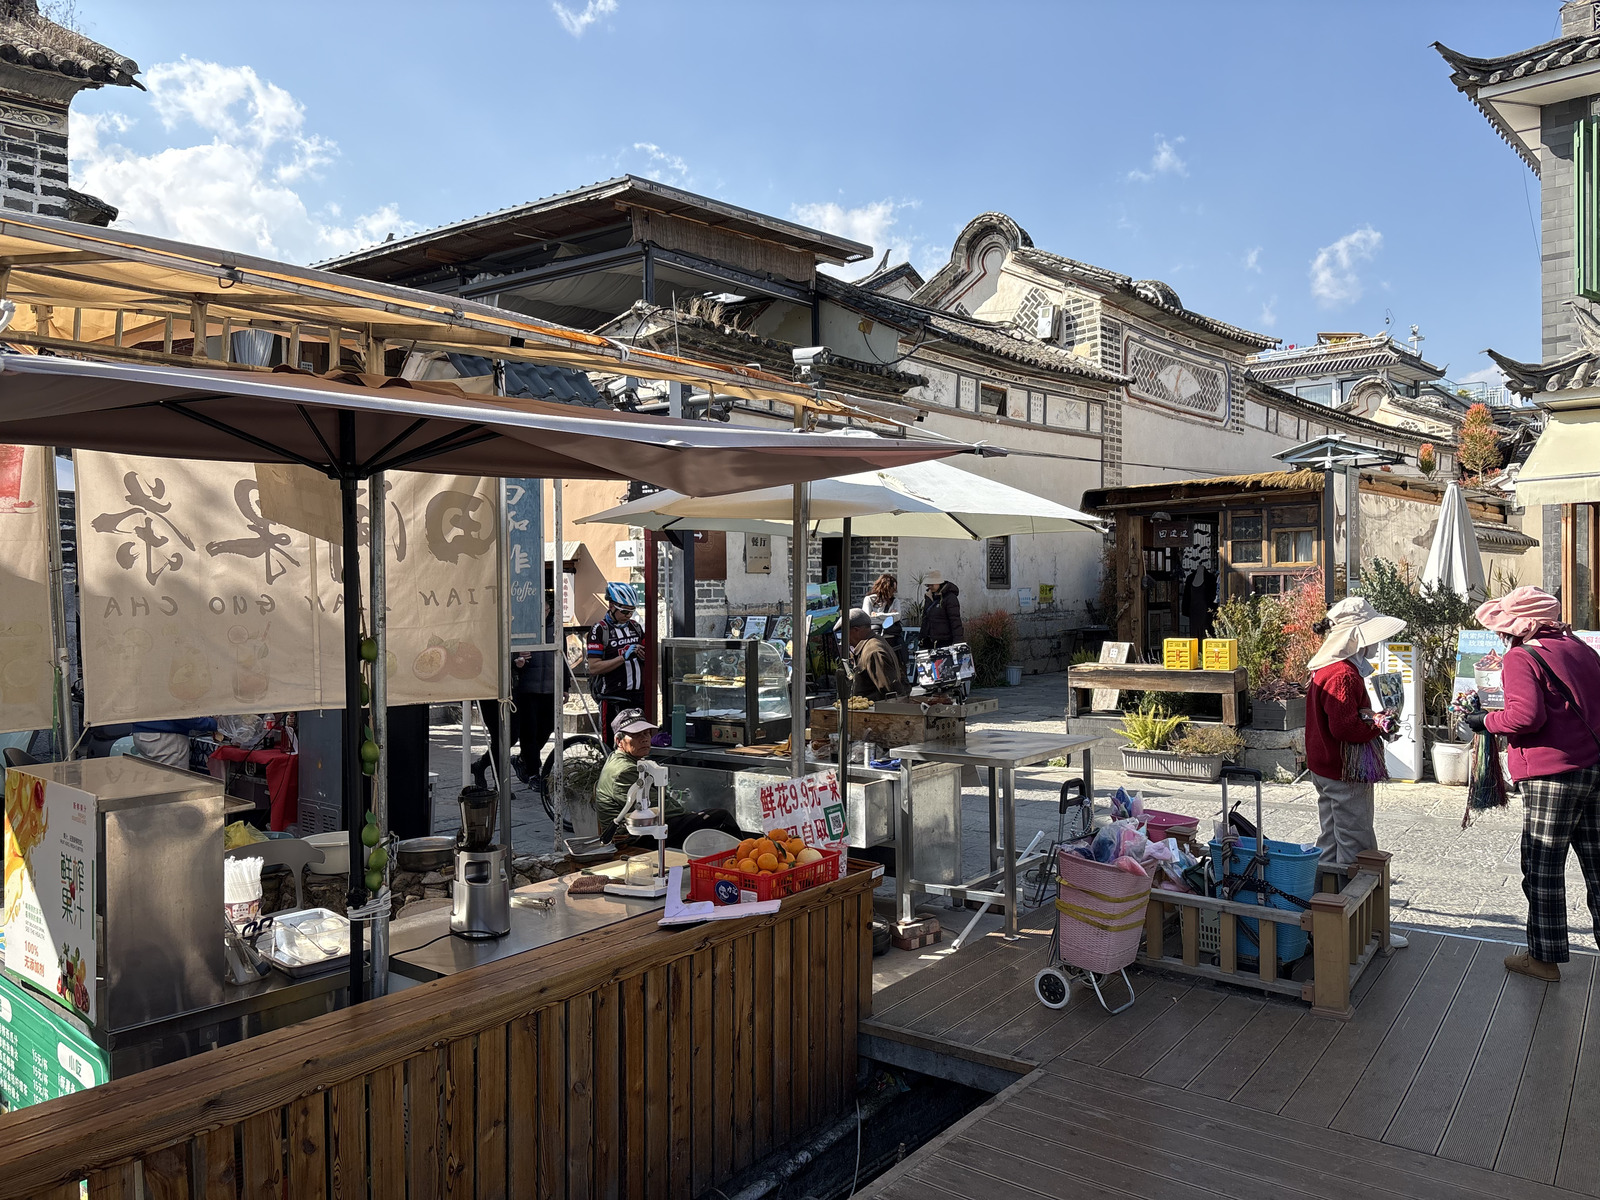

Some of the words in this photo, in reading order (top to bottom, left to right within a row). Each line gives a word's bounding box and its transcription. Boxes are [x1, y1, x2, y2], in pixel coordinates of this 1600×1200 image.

[751, 536, 768, 547] 餐厅
[510, 580, 537, 603] Coffee
[618, 636, 640, 646] GIANT
[24, 940, 39, 957] 100%
[24, 955, 45, 978] 无添加剂
